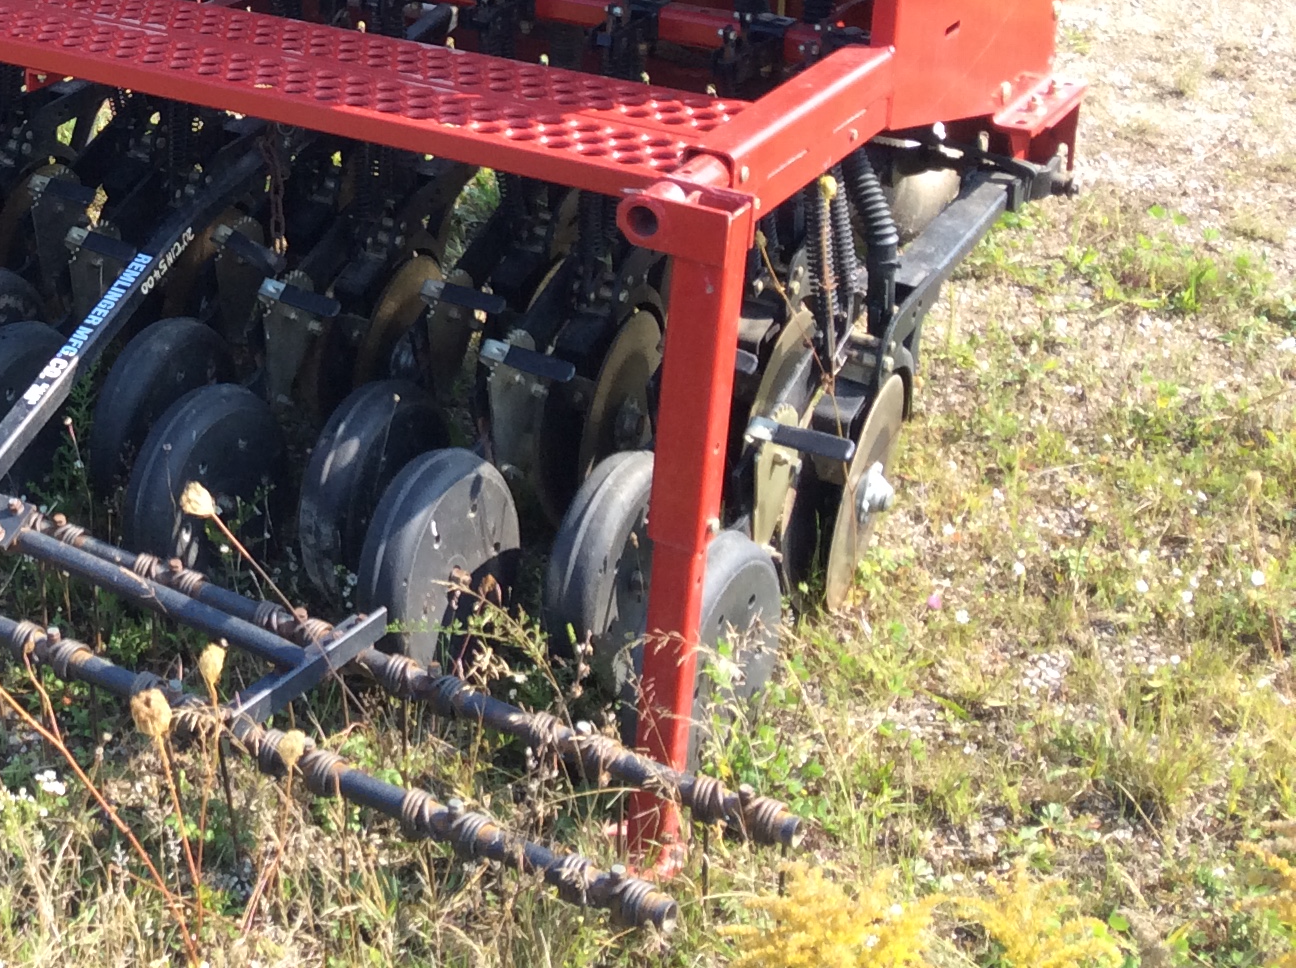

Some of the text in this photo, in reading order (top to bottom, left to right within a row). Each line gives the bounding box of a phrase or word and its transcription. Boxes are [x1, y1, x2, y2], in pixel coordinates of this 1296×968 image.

[39, 253, 154, 380] REMLINGER MFG. CO.
